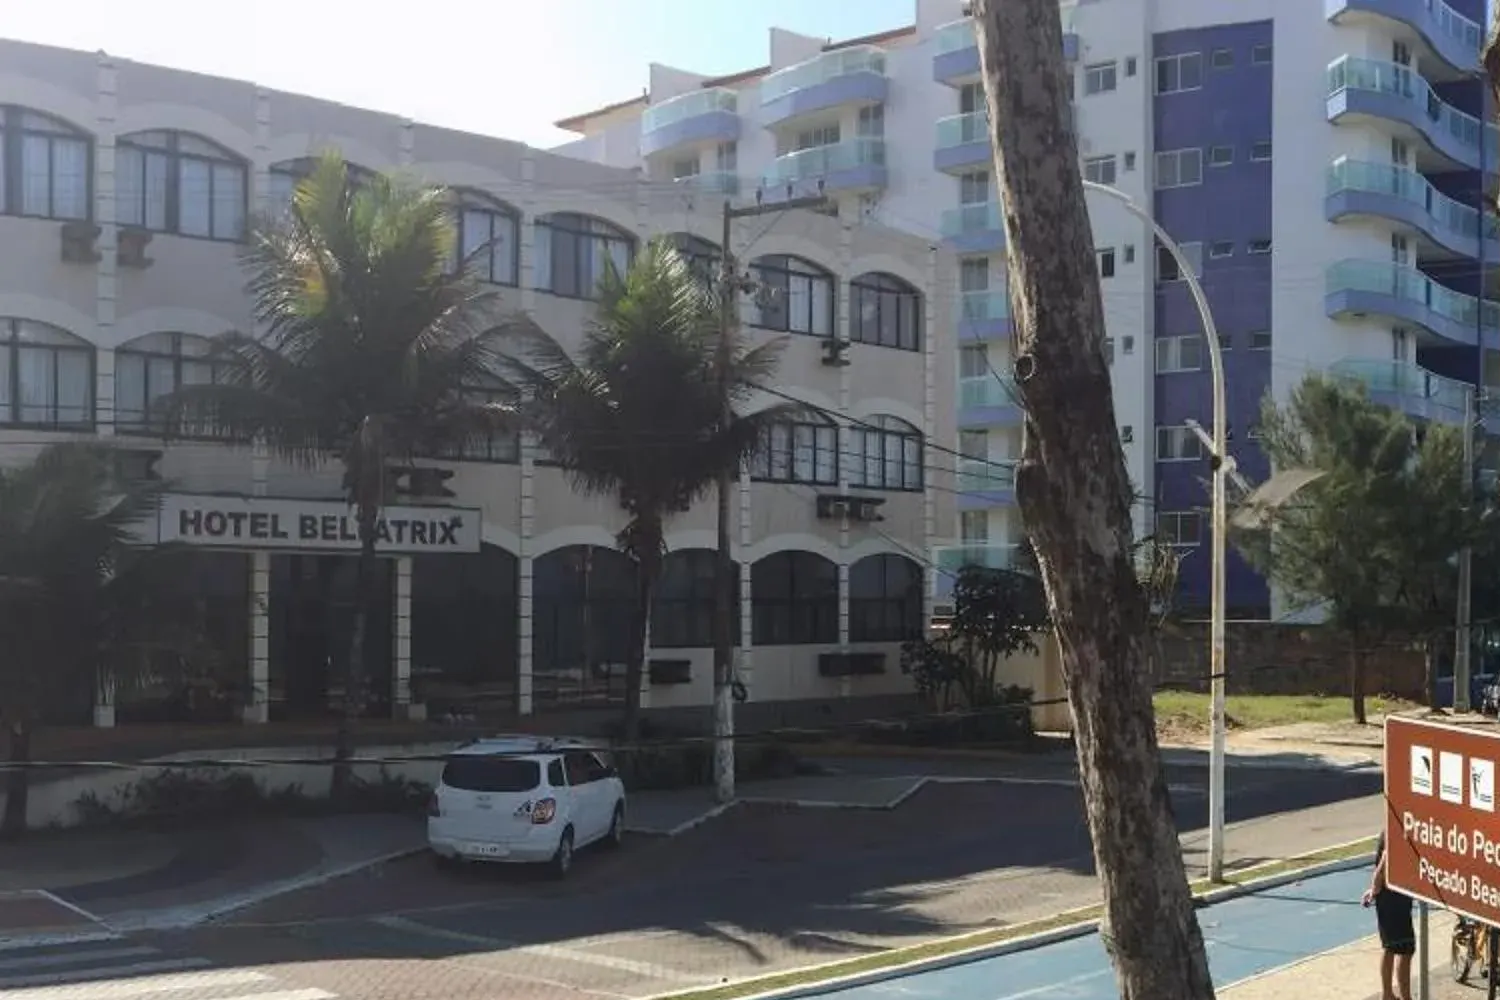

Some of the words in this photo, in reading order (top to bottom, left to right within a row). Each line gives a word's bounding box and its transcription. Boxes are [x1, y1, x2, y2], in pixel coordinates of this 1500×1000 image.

[179, 509, 288, 539] HOTEL
[299, 513, 461, 545] BELATRIX
[1403, 812, 1442, 848] Praia
[1447, 824, 1467, 854] do
[1419, 858, 1466, 896] Pecado
